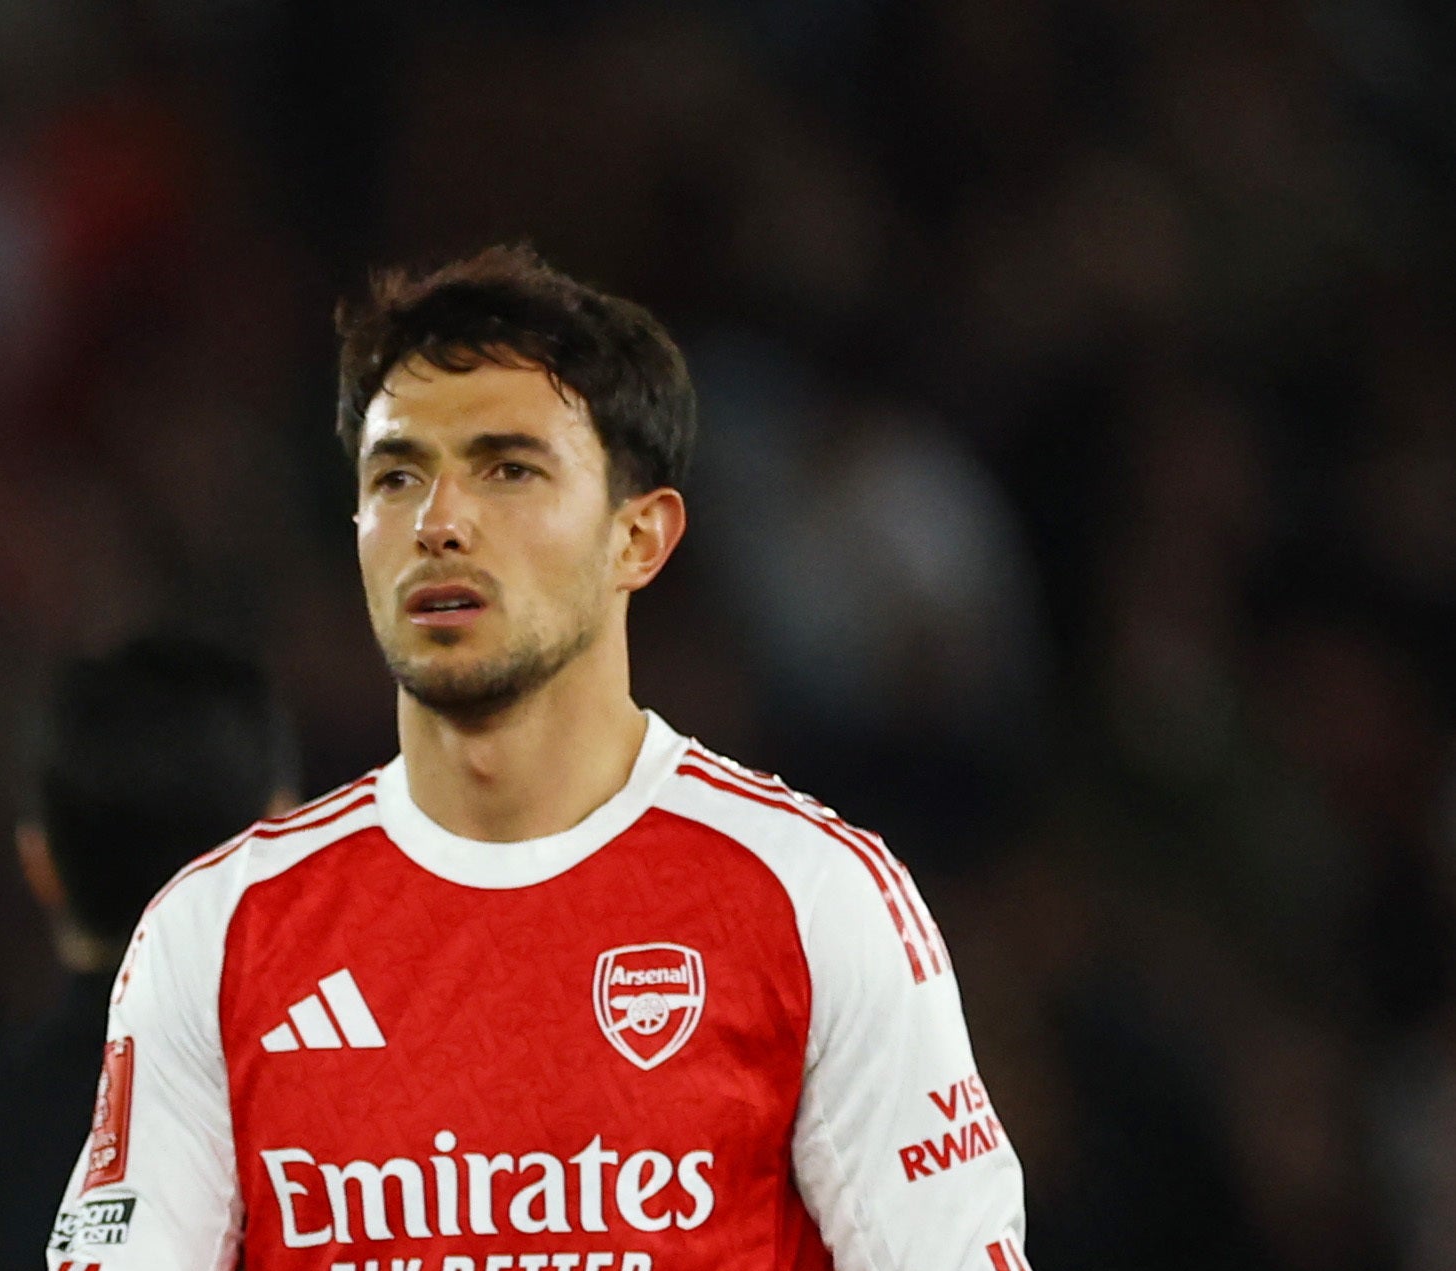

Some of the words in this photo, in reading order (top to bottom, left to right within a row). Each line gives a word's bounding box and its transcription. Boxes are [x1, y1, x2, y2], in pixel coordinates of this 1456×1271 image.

[610, 964, 689, 986] Arsenal
[927, 1075, 986, 1122] VIS
[261, 1130, 715, 1248] Emirates
